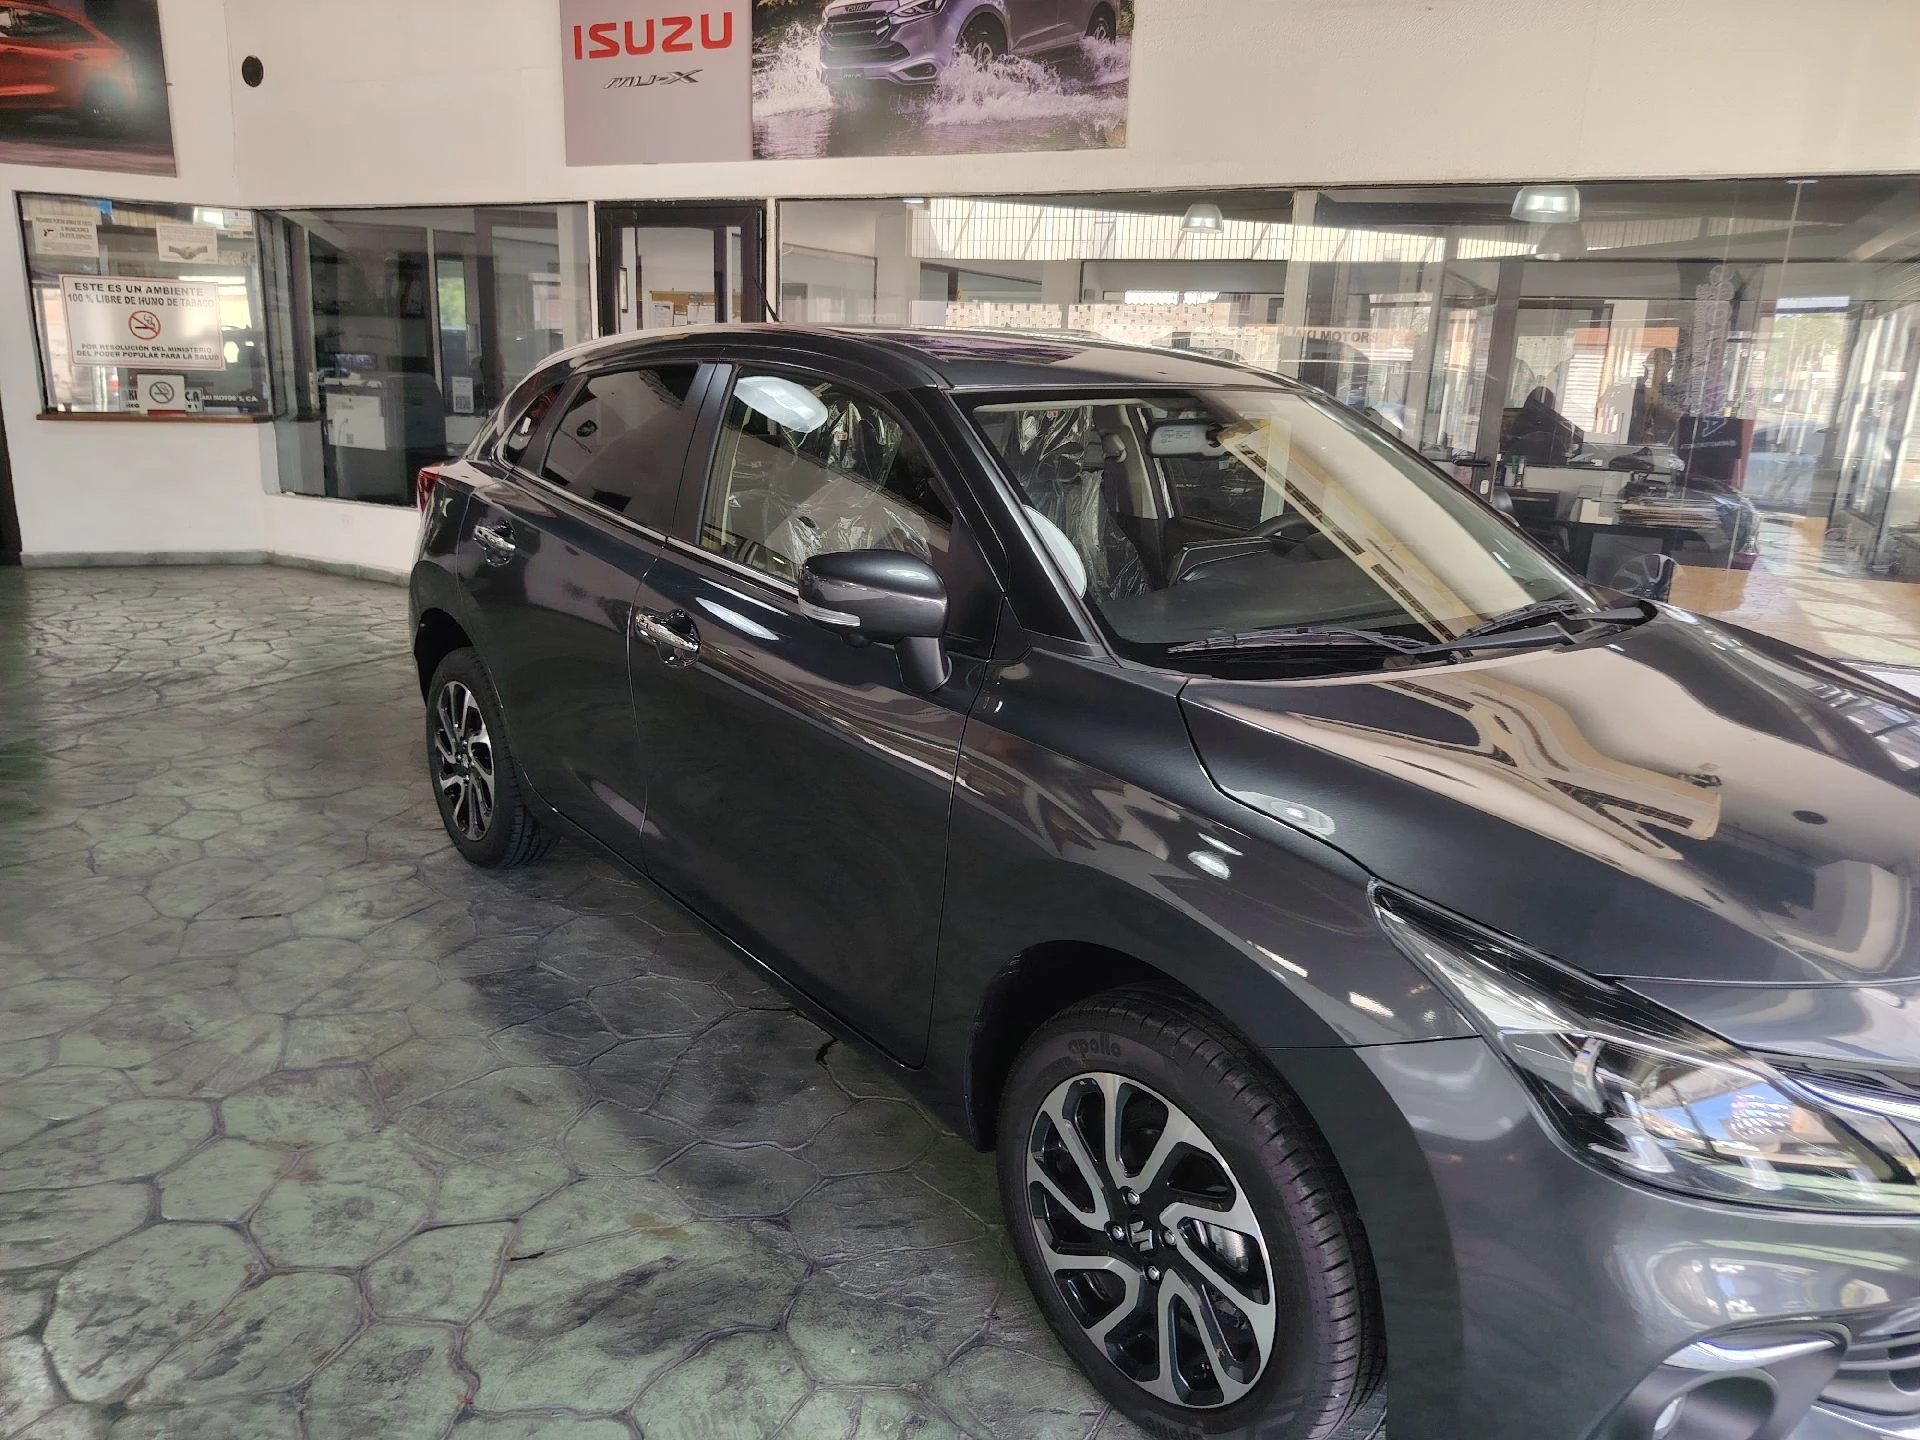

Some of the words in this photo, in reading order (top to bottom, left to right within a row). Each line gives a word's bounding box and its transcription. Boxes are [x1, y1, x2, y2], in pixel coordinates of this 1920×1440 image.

[573, 11, 733, 60] ISUZU
[74, 282, 104, 293] ESTE
[107, 284, 122, 293] ES
[126, 285, 142, 294] UN
[145, 286, 204, 297] AMBIENTE
[68, 293, 83, 303] 100
[96, 294, 122, 305] LIBRE
[124, 296, 136, 306] DE
[167, 298, 178, 307] DE
[181, 298, 215, 309] TABACO
[94, 350, 120, 358] PODER
[122, 351, 160, 359] POPULAR
[160, 352, 181, 360] PARA
[167, 346, 212, 354] MINISTERIO
[1067, 1033, 1122, 1058] apollo
